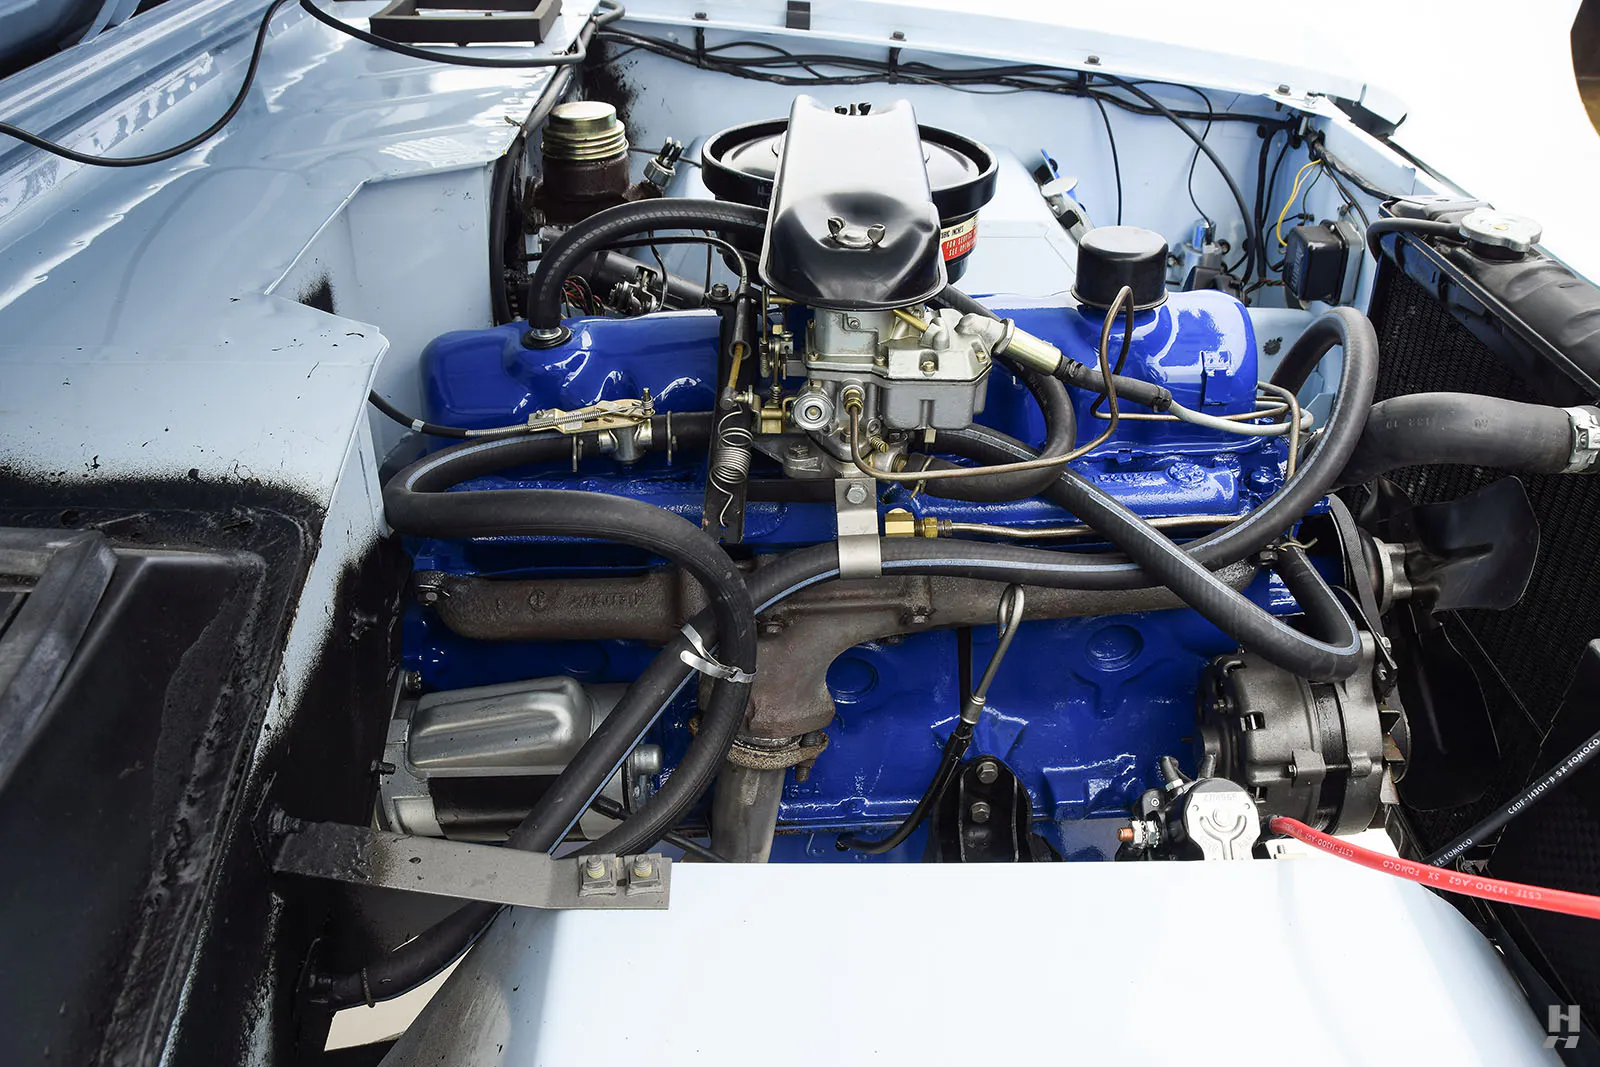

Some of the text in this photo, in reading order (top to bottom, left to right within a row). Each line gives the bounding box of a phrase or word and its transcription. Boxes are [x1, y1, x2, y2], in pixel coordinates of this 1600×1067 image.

[1567, 738, 1600, 768] FOMOCO
[1382, 859, 1420, 877] FOMOCO
[1427, 871, 1440, 881] SX
